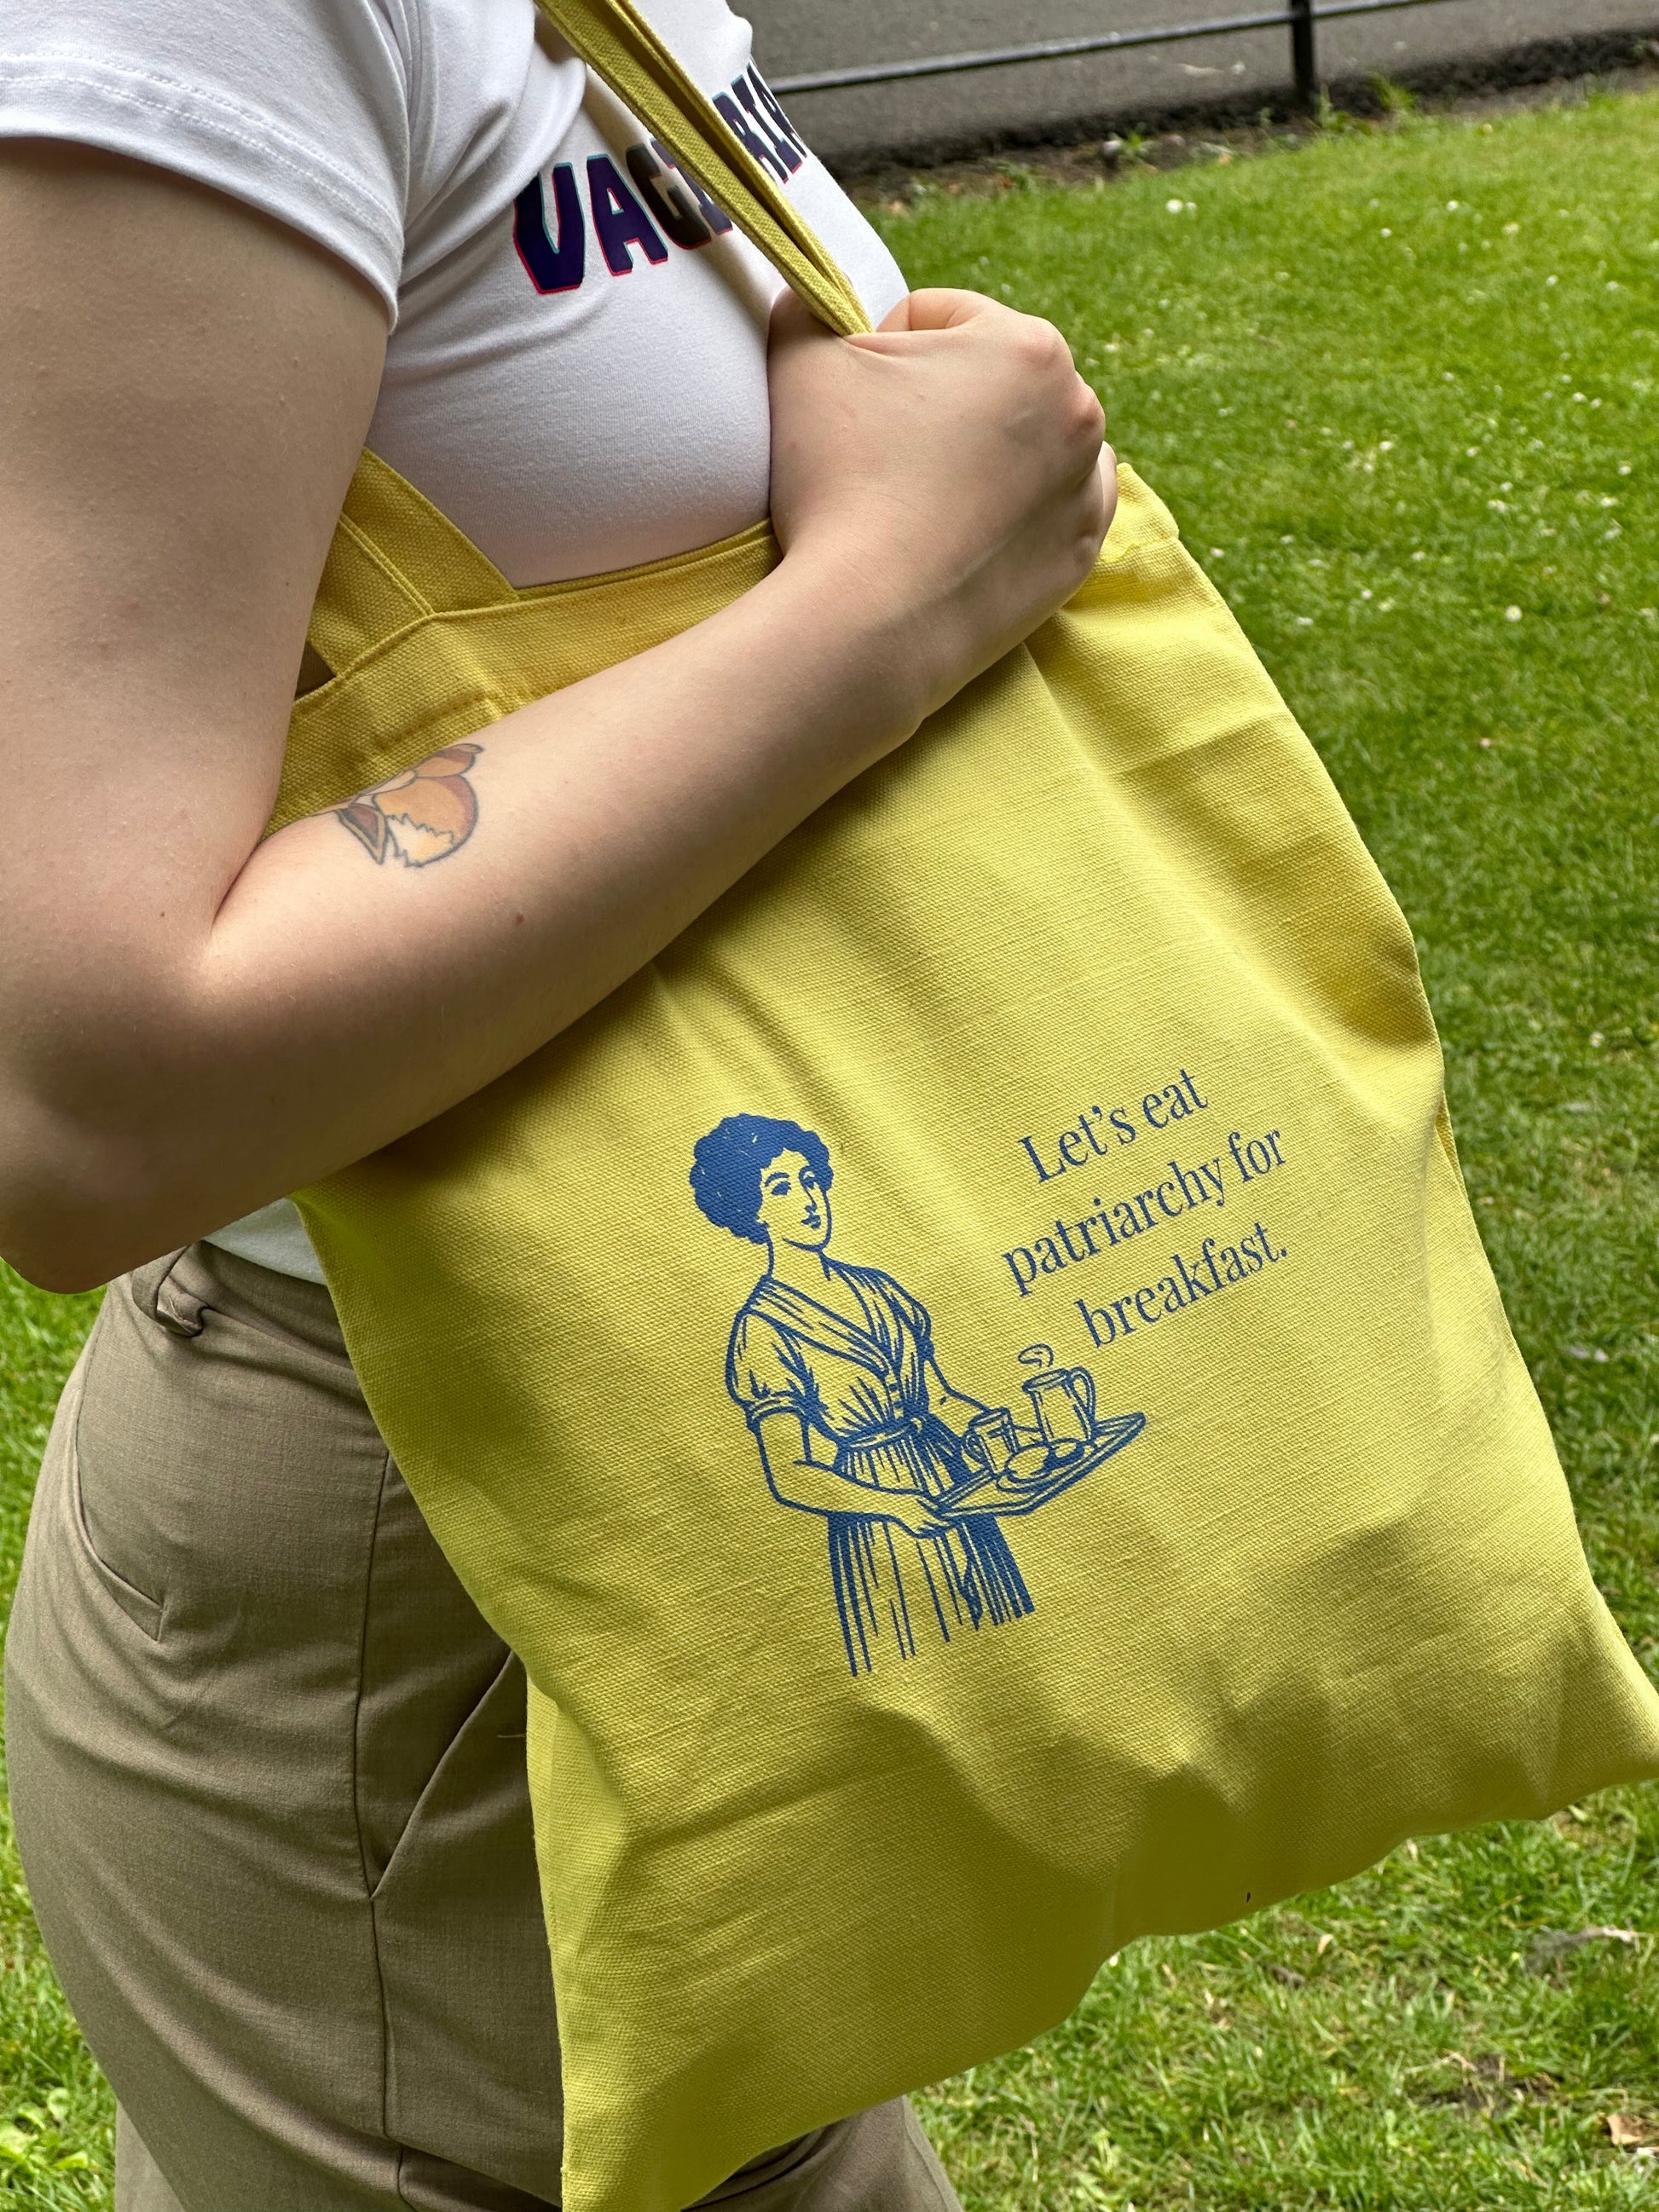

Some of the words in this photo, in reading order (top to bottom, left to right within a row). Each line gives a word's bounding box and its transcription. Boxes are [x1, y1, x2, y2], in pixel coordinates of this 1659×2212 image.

[1018, 1105, 1137, 1183] Let’s
[1142, 1068, 1209, 1129] eat
[1002, 1157, 1226, 1297] patriarchy
[1228, 1127, 1286, 1183] for
[1073, 1222, 1288, 1349] breakfast.
